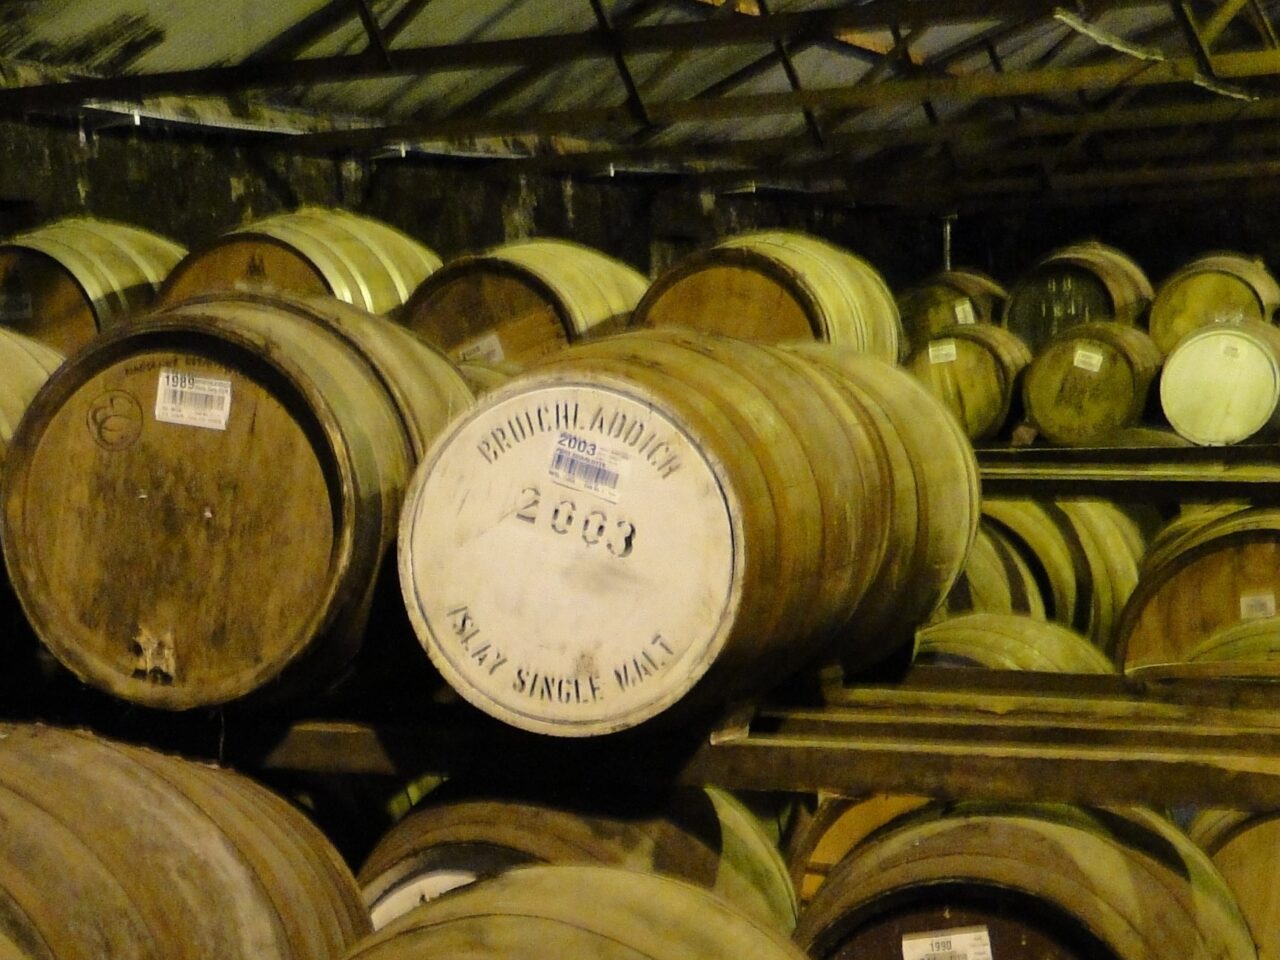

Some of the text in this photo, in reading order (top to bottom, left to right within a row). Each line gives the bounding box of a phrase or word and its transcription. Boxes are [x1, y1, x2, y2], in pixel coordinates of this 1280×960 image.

[164, 374, 195, 390] 1989
[476, 401, 682, 480] BRUICHLADDICH
[557, 433, 597, 456] 2003
[516, 486, 637, 559] 2003
[447, 606, 675, 705] ISLAY SINGLE MALT
